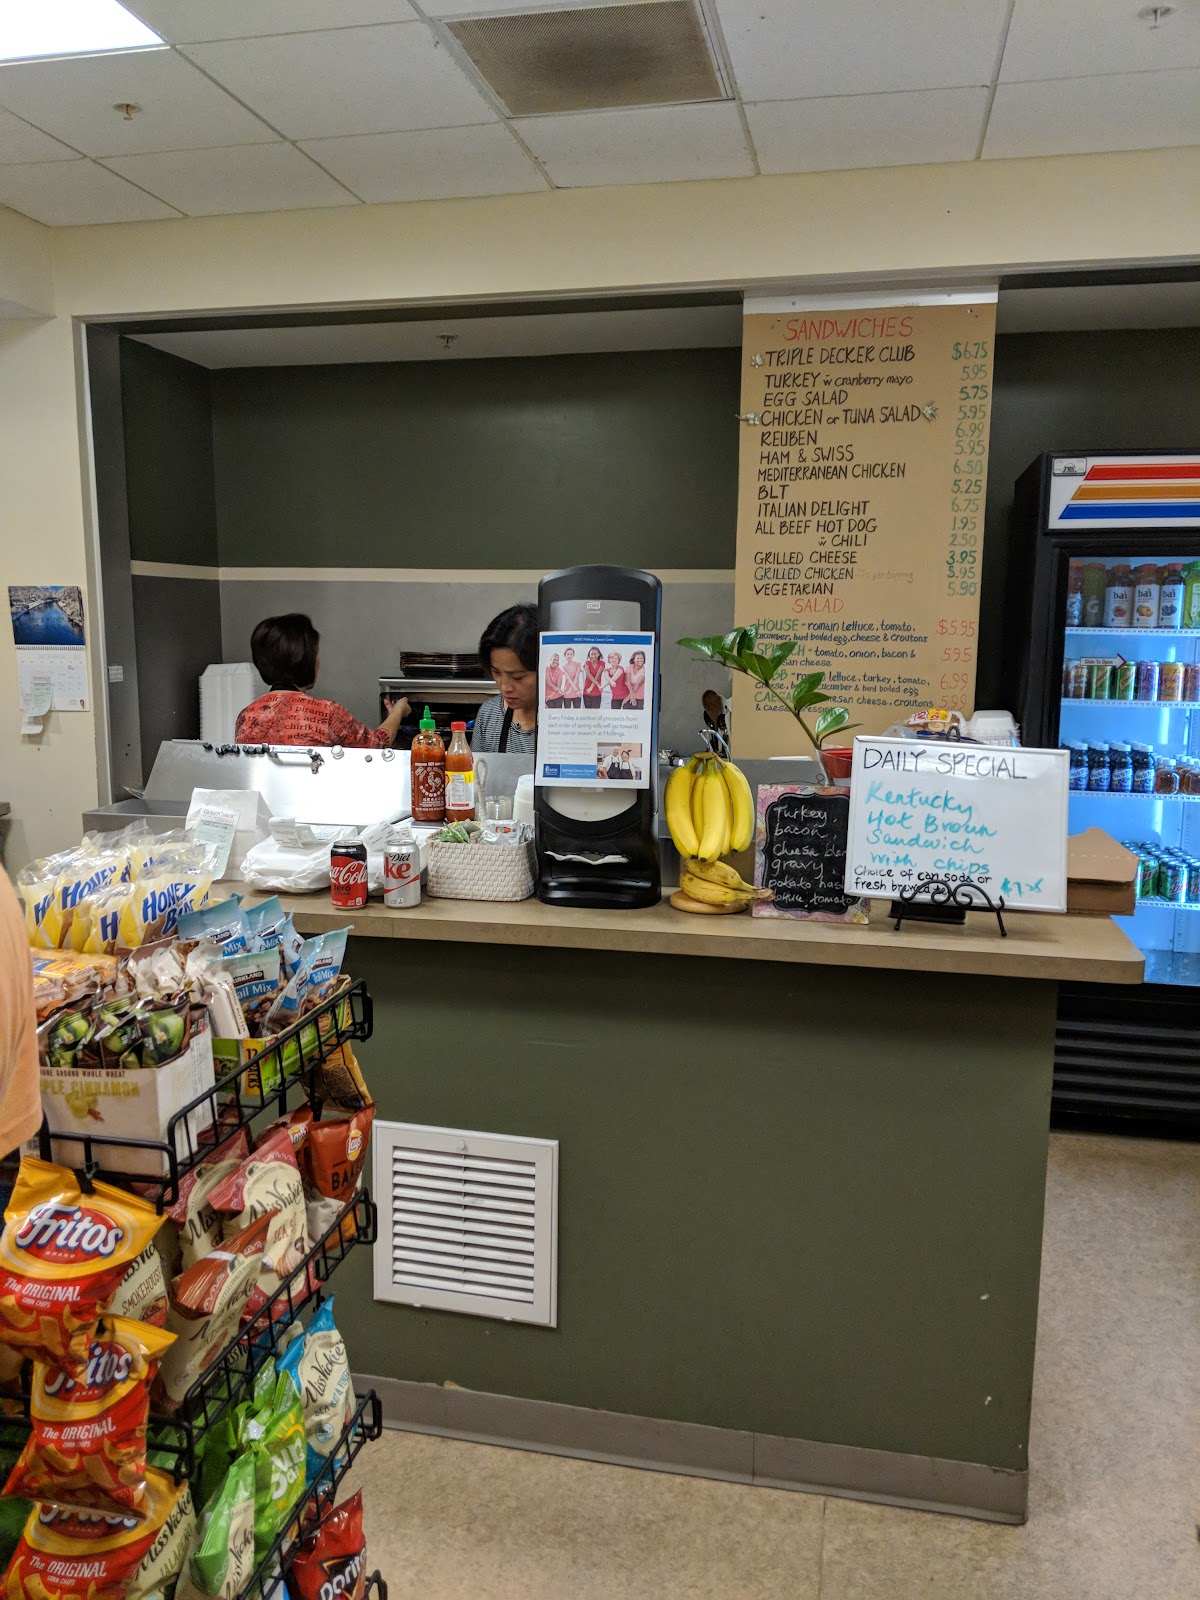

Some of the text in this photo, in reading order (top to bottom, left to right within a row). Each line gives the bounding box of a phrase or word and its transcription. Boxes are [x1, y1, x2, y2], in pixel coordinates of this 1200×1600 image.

[783, 316, 914, 341] SANDWICHES
[766, 342, 989, 367] TRIPLE DECKER CLUB $6.75
[765, 364, 988, 389] TURKEY cranberry mayo 5.95
[763, 385, 989, 407] EGG SALAD 5.75
[761, 404, 987, 427] CHICKEN or TUNA SALAD 5.95
[760, 422, 985, 447] REUBEN 6.99
[760, 440, 985, 465] HAM & SWISS 5.95
[757, 465, 848, 482] MEDITERRANEAN
[851, 462, 906, 479] CHICKEN
[758, 478, 982, 500] BLT 5.25
[758, 497, 979, 517] ITALIAN DELIGHT 6.75
[755, 516, 977, 535] ALL BEEF HOT DOG 1.95
[831, 533, 977, 547] CHILI 2.50
[754, 550, 977, 565] GRILLED CHEESE 3.95
[754, 567, 801, 581] GRILLED
[804, 566, 854, 580] CHICKEN
[946, 566, 976, 580] 5.95
[753, 583, 834, 596] VEGETARIAN
[792, 597, 845, 614] SALAD
[757, 618, 799, 631] HOUSE
[936, 618, 976, 637] $5.95
[810, 633, 833, 642] boiled
[883, 633, 889, 641] &
[881, 647, 908, 658] bacon
[940, 672, 969, 691] 6.99
[903, 687, 919, 697] egg
[863, 747, 1027, 779] DAILY SPECIAL
[866, 780, 972, 825] Kentucky
[924, 814, 997, 838] Brown
[867, 829, 985, 854] Sandwich
[389, 853, 411, 861] Diet
[870, 850, 990, 876] with chips
[768, 875, 812, 890] potato
[854, 865, 992, 884] Choice of can soda or
[854, 877, 887, 890] fresh
[142, 882, 197, 923] HONEY
[224, 940, 243, 954] Mix
[322, 969, 334, 979] Mix
[252, 983, 273, 994] Mix
[70, 1080, 140, 1097] CINNAMON
[16, 1202, 124, 1256] Fritos
[4, 1277, 81, 1301] The ORIGINAL
[34, 1298, 52, 1309] CHIPS
[304, 1379, 327, 1409] Miss
[41, 1417, 117, 1441] The ORIGINAL
[29, 1555, 107, 1578] The ORIGINAL
[60, 1577, 76, 1586] CHIPS
